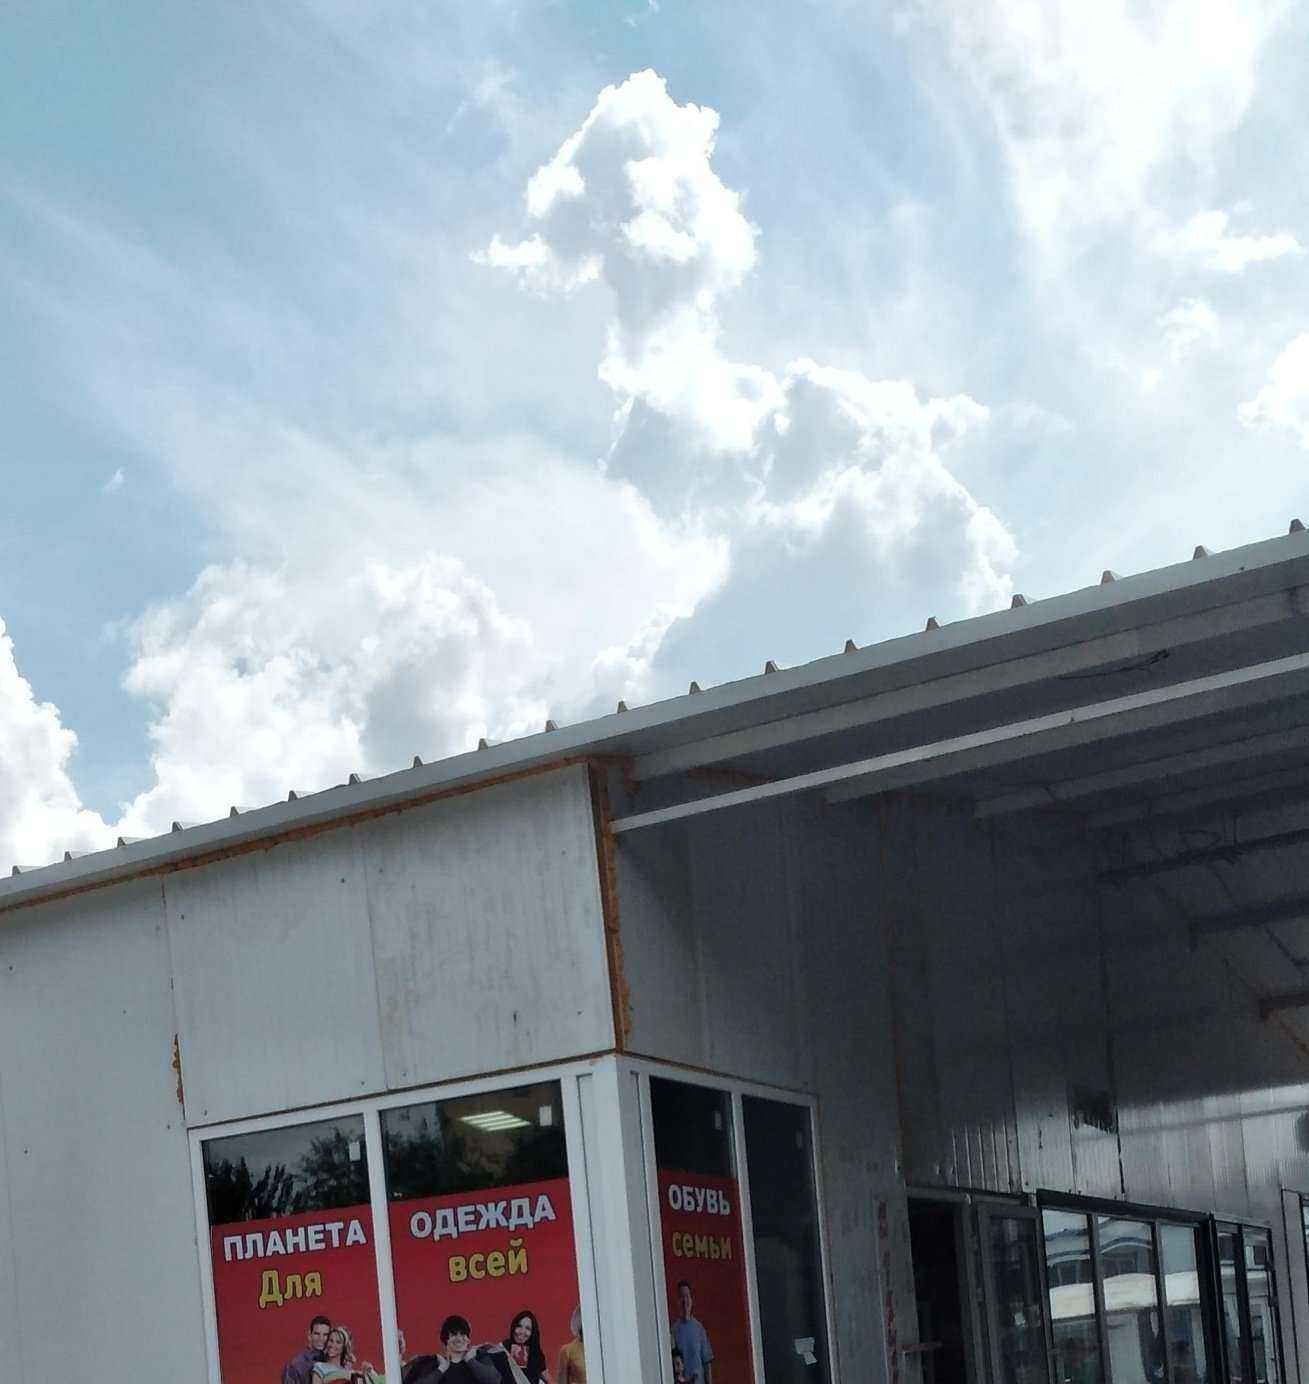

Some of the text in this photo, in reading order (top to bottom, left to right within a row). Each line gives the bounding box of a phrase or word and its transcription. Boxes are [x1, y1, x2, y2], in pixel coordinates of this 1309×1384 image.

[410, 1195, 555, 1241] ОДЕЖДА
[669, 1185, 731, 1215] ОБУВЬ
[223, 1219, 366, 1261] ПЛАНЕТА
[672, 1231, 732, 1259] семьи
[448, 1239, 528, 1282] всей
[258, 1270, 322, 1309] Для
